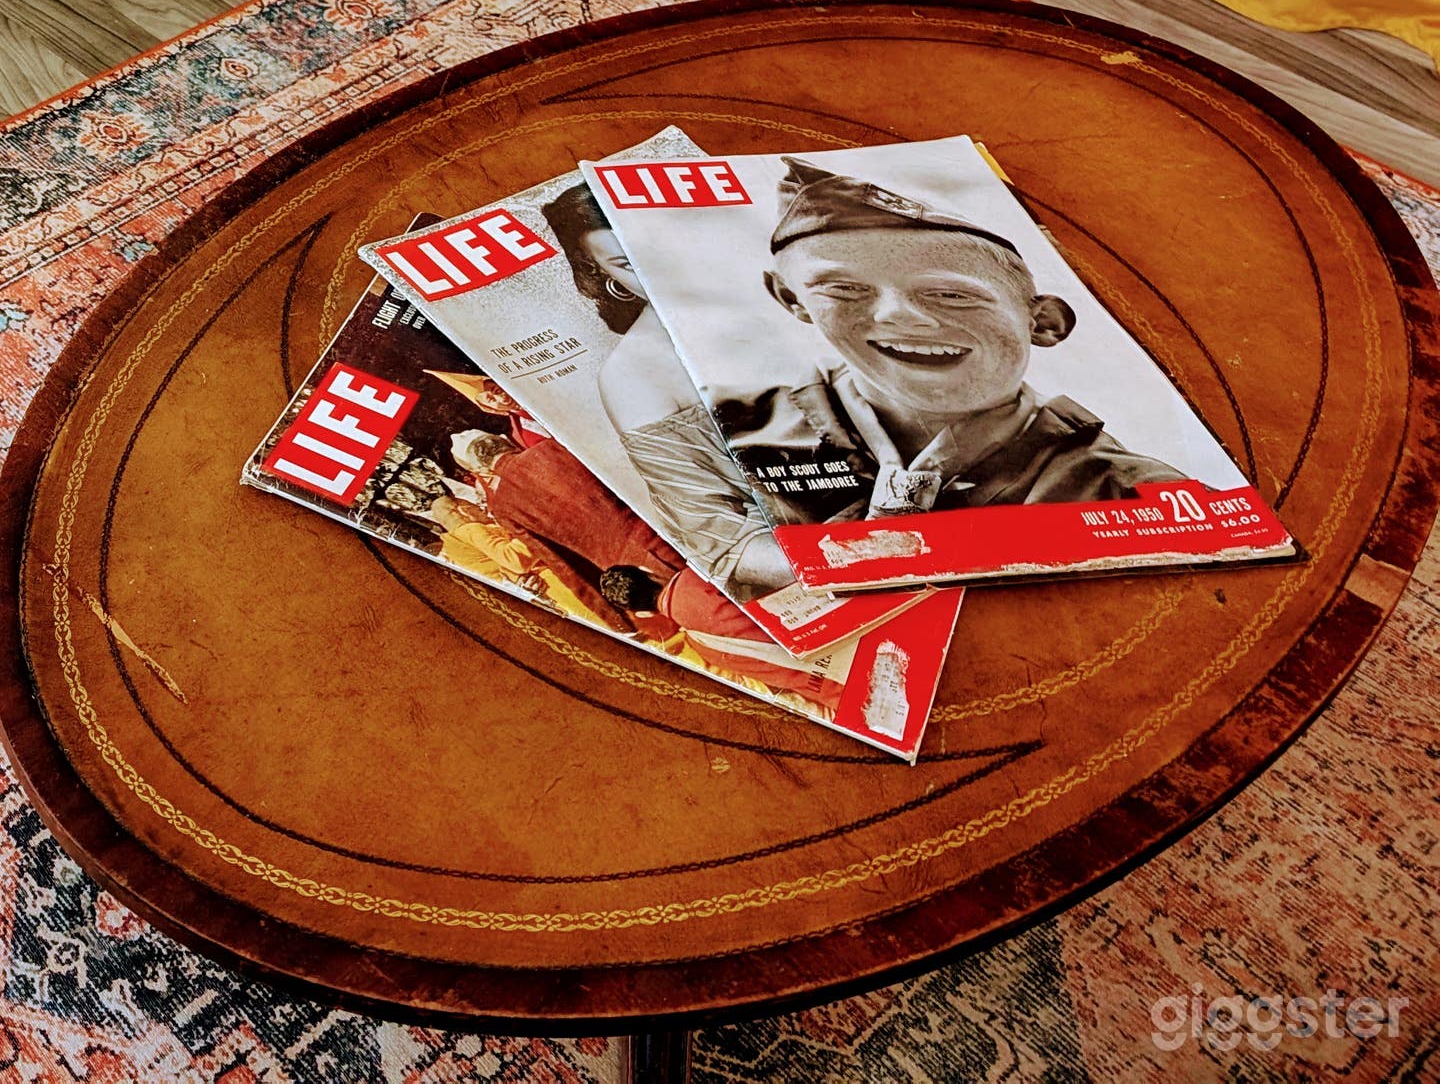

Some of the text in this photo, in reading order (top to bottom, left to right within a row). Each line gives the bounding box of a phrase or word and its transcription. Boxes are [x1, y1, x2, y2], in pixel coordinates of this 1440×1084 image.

[602, 166, 745, 204] LIFE
[385, 215, 546, 295] LIFE
[371, 299, 401, 329] FLIGHT
[490, 328, 559, 359] THE PROGRESS
[497, 337, 582, 374] OF A RISING STAR
[554, 364, 578, 377] ROMAN
[273, 370, 407, 496] LIFE
[756, 461, 850, 478] A BOY SCOUT GOES
[762, 475, 859, 493] TO THE JAMBOREE
[1080, 510, 1109, 526] JULY
[1132, 507, 1164, 523] 1950
[1160, 489, 1206, 523] 20
[1209, 497, 1252, 516] CENTS
[1093, 514, 1260, 538] YEARLY SUBSCRIPTION $6.00
[807, 668, 826, 693] LAMA
